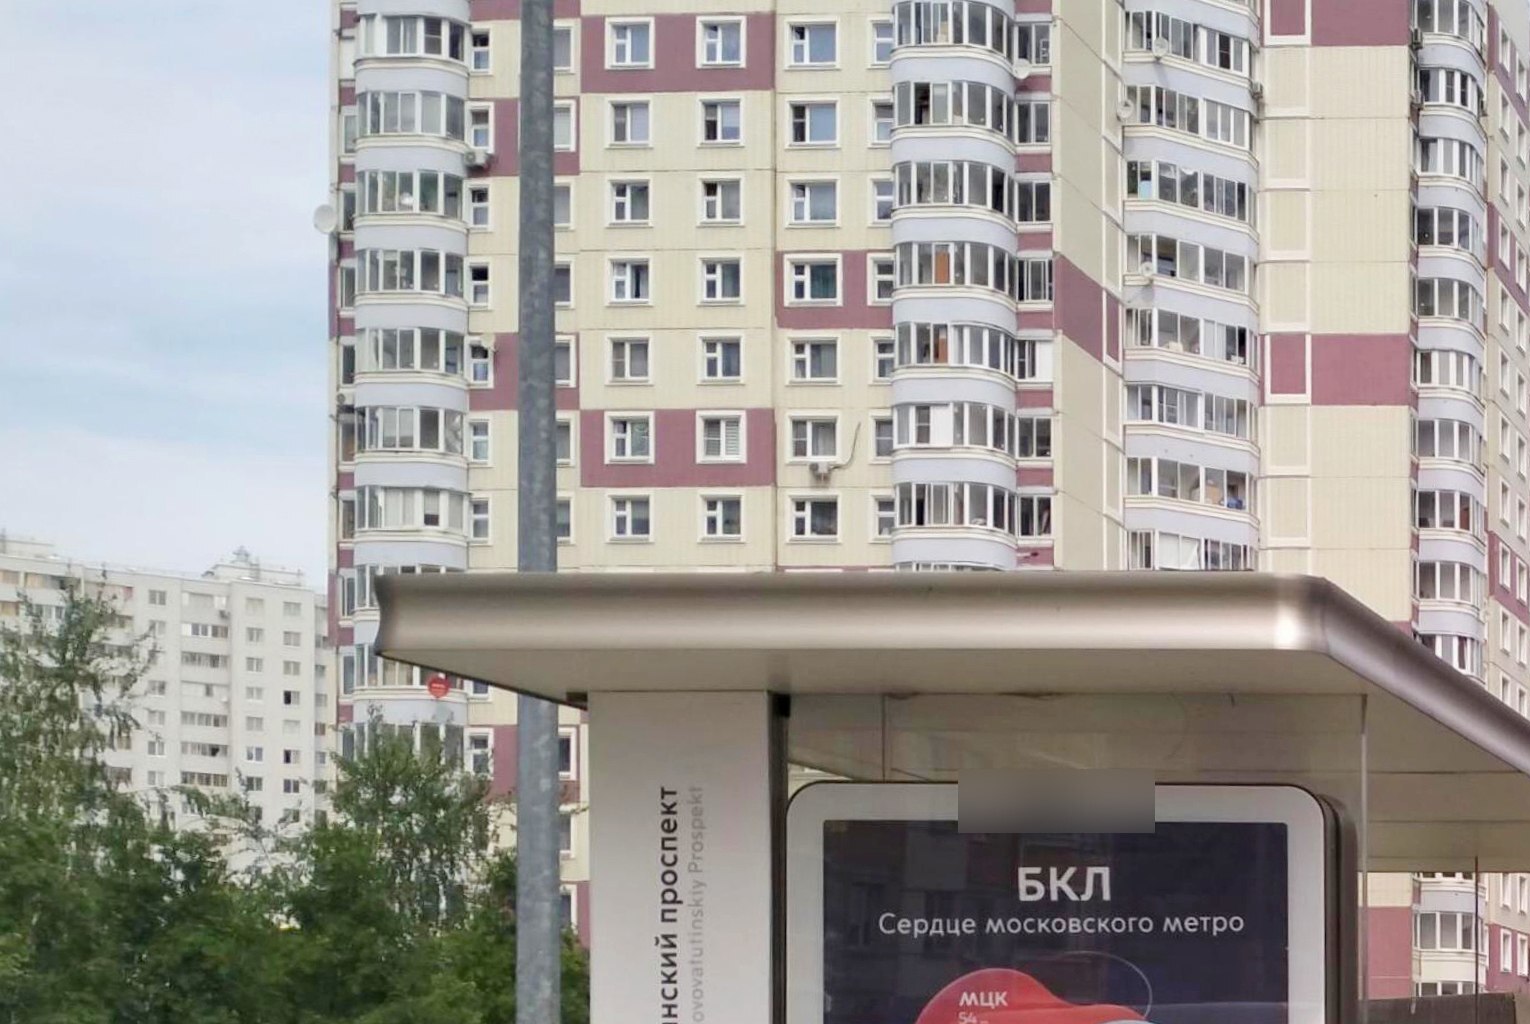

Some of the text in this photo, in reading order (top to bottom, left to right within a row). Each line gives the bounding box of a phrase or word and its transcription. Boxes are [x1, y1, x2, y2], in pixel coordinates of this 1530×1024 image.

[687, 785, 707, 873] Prospekt
[660, 786, 684, 924] проспект
[1017, 866, 1112, 902] БКЛ
[878, 912, 1245, 939] Сердце московского метро
[958, 990, 1009, 1010] МЦК
